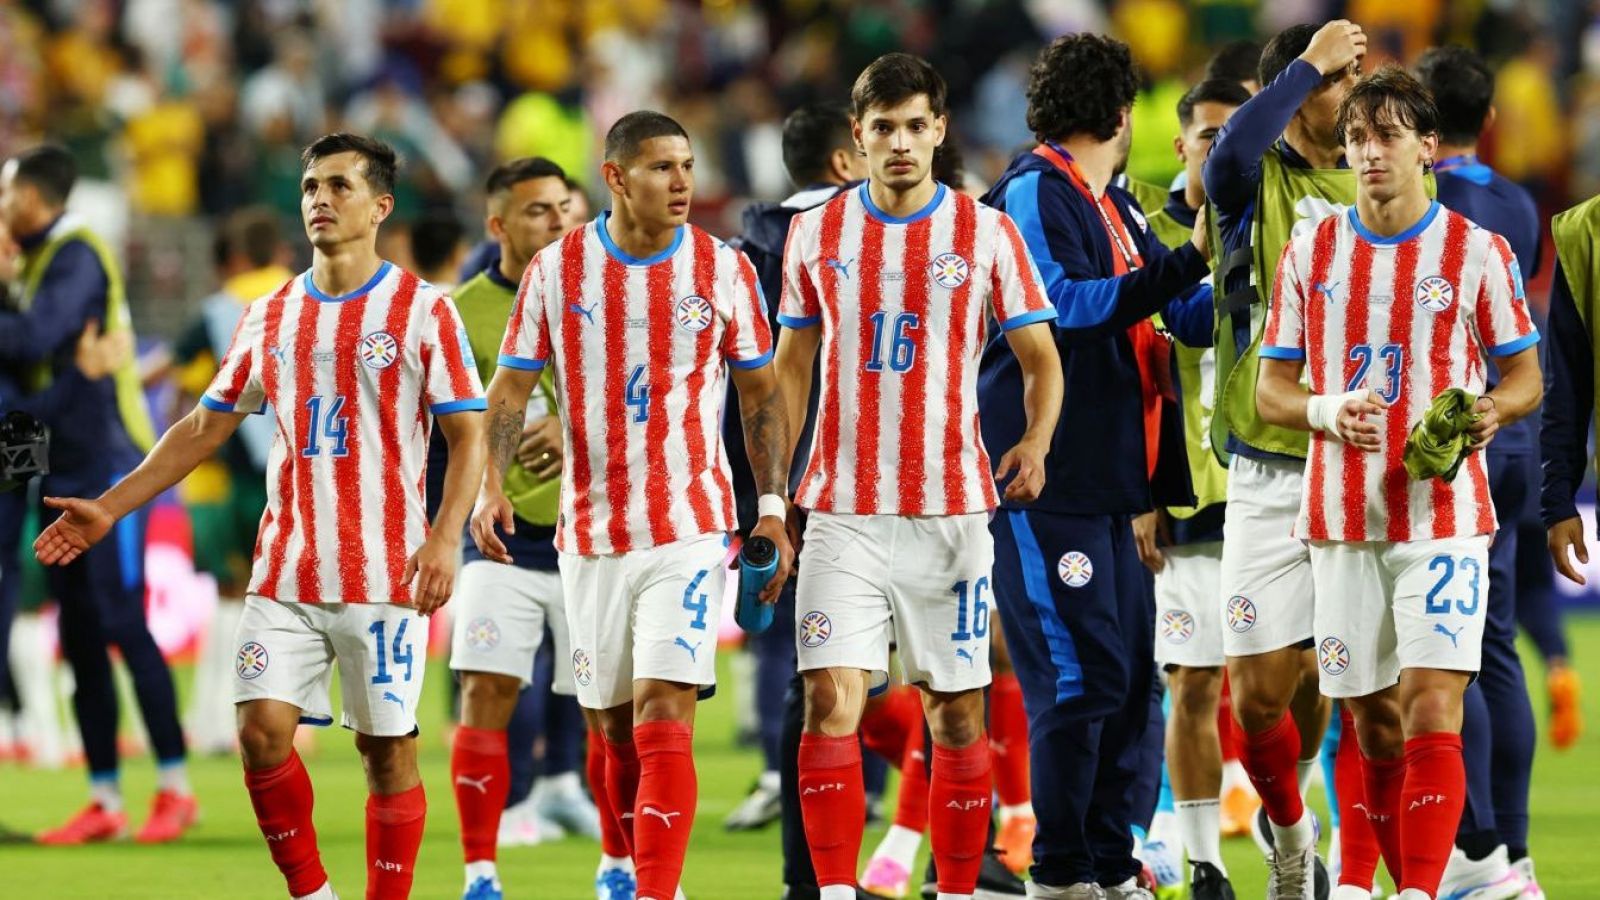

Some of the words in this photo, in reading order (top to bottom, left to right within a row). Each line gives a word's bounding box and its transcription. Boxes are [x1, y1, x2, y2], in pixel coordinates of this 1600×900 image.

[865, 310, 919, 373] 16
[624, 363, 651, 423] 4
[1346, 343, 1402, 405] 23
[302, 396, 349, 458] 14
[682, 569, 709, 630] 4
[951, 576, 989, 641] 16
[1425, 555, 1480, 616] 23
[368, 618, 413, 684] 14
[945, 797, 989, 810] APF
[1408, 794, 1447, 811] APF
[374, 858, 403, 873] APF
